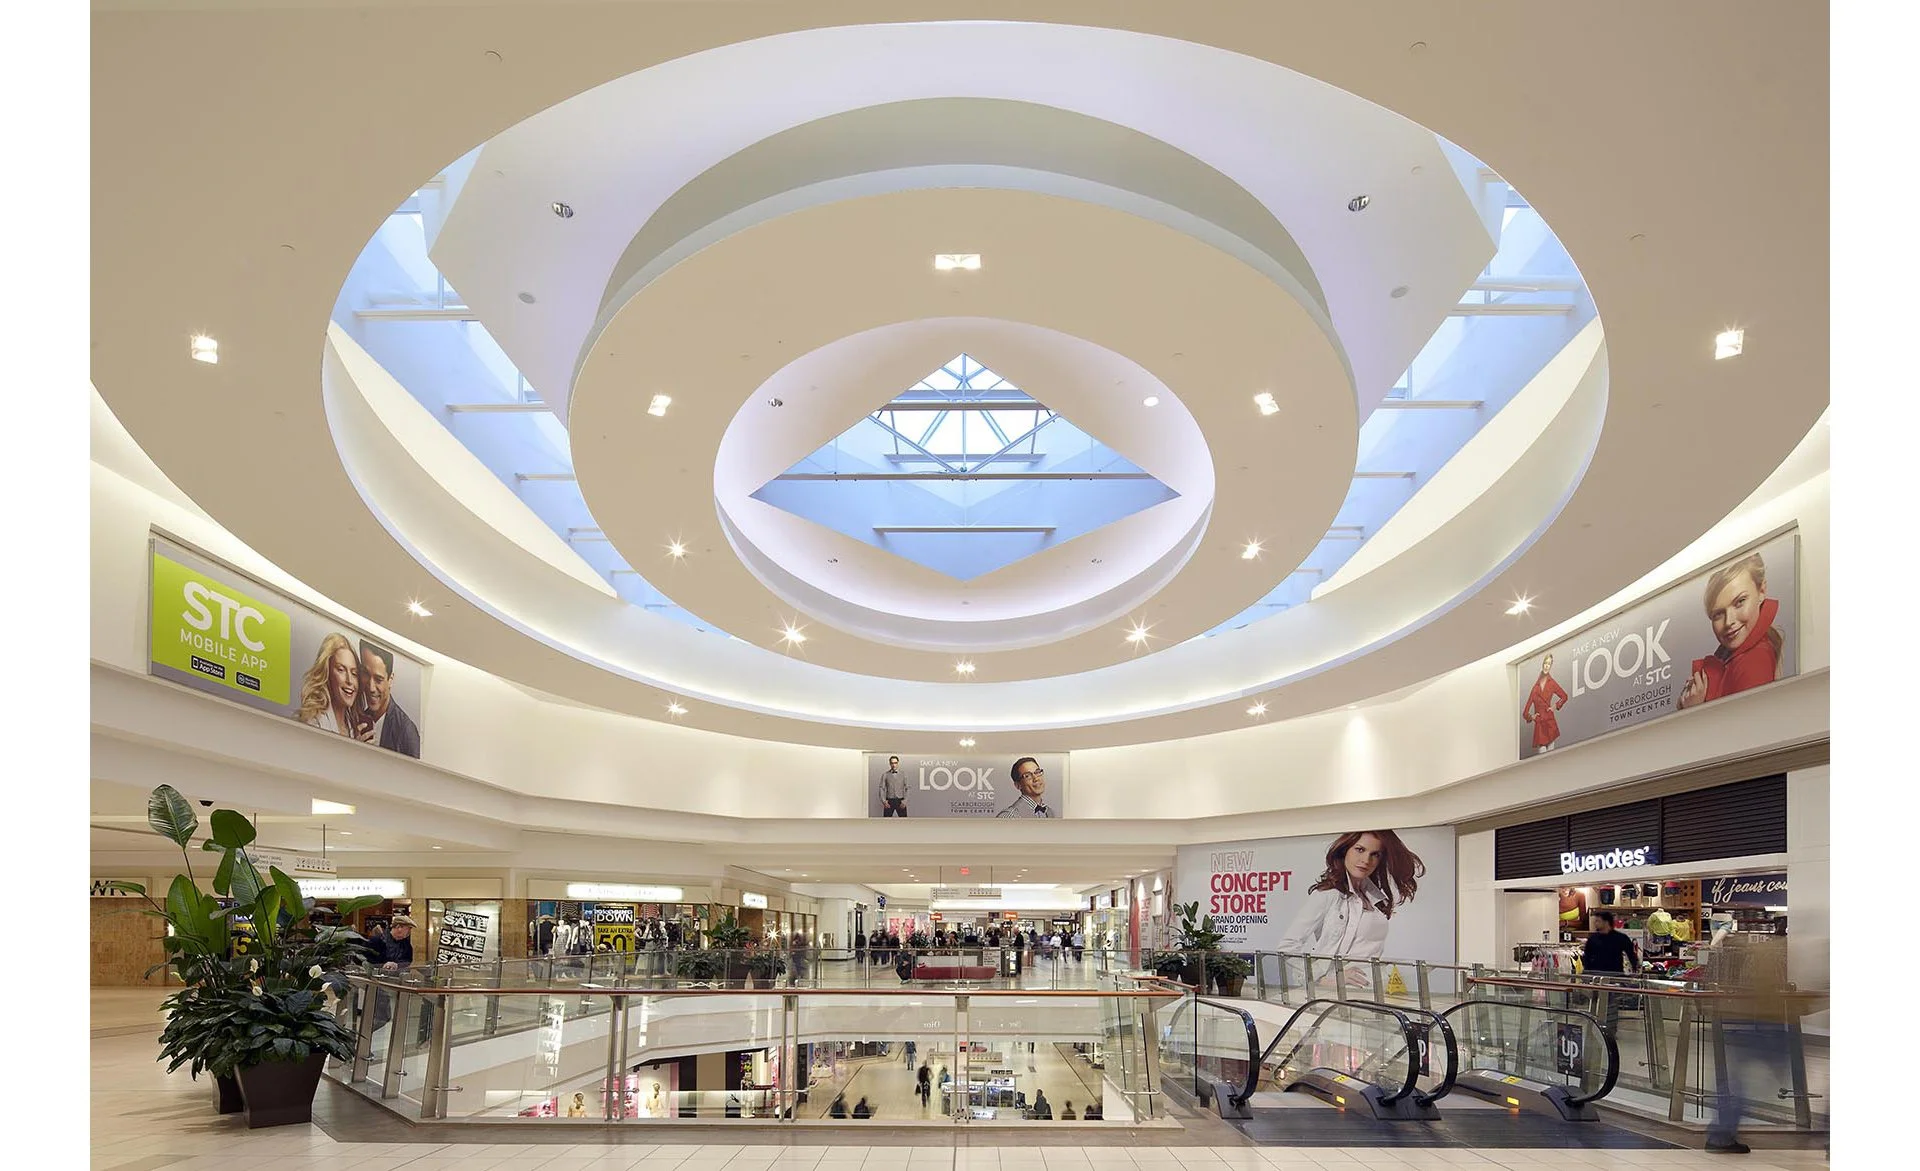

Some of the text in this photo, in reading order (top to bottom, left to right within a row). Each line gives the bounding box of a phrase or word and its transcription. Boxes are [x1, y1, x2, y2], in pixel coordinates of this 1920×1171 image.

[182, 581, 267, 652] STC
[180, 628, 237, 662] MOBILE
[241, 653, 268, 672] APP
[1572, 643, 1590, 658] TAKE
[1600, 628, 1620, 646] NEW
[1572, 618, 1671, 697] LOOK
[1633, 665, 1671, 687] AT STC
[1610, 684, 1672, 712] SCARBOROUGH
[1610, 698, 1671, 722] TOWN CENTRE
[920, 767, 994, 790] LOOK
[977, 792, 994, 800] STC
[1211, 851, 1254, 872] NEW
[1211, 871, 1292, 893] CONCEPT
[1711, 877, 1726, 903] if
[1722, 879, 1766, 903] jeans
[1210, 894, 1266, 914] STORE
[444, 915, 487, 930] SALE
[446, 910, 488, 921] RENOVATION
[597, 914, 633, 922] DOWN
[1211, 915, 1268, 924] GRAND OPENING
[442, 930, 484, 941] RENOVATION
[1230, 925, 1247, 933] 2011
[440, 935, 483, 951] SALE
[439, 949, 481, 961] RENOVATION
